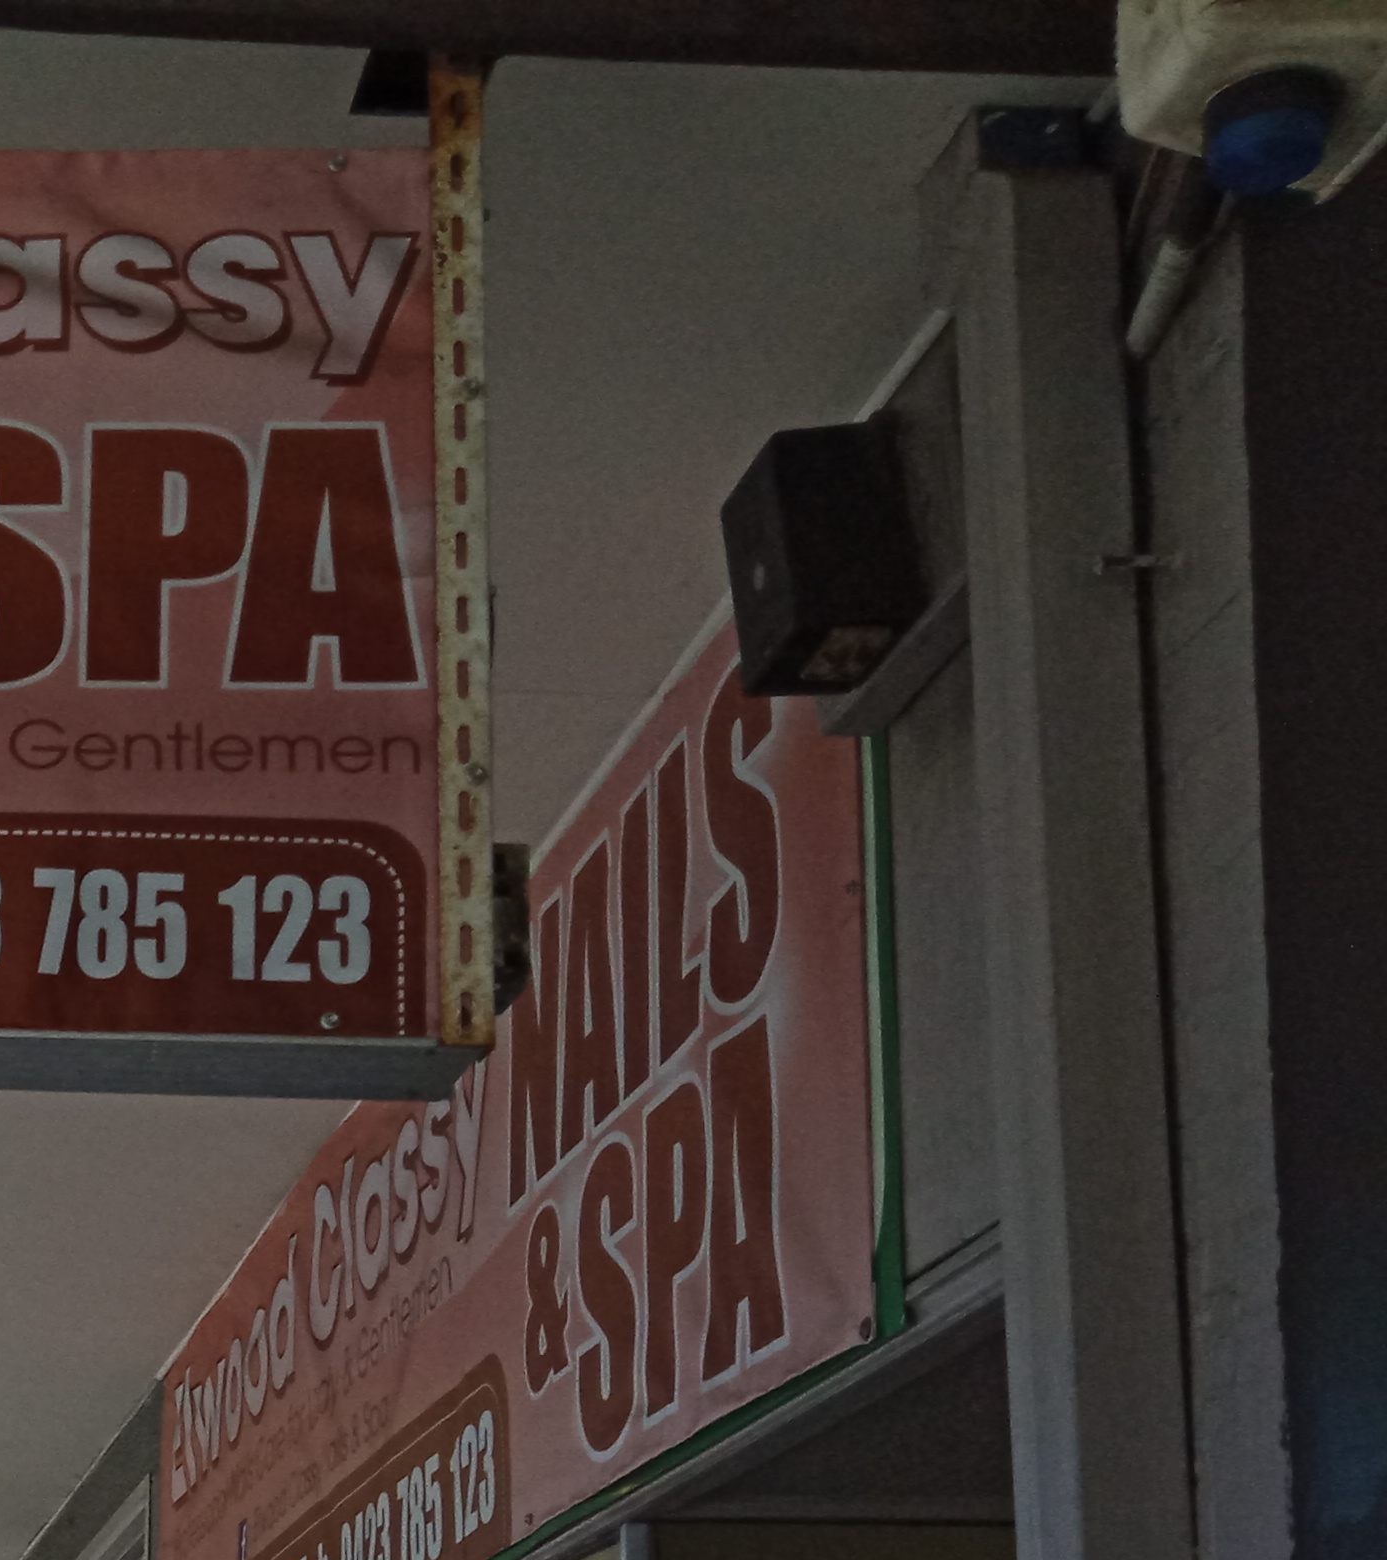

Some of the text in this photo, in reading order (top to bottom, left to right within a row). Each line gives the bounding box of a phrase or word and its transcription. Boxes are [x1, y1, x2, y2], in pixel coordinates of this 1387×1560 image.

[7, 718, 423, 777] Gentlemen
[32, 866, 201, 981] 785
[217, 870, 372, 985] 123
[508, 655, 781, 1214] NAILS
[172, 1231, 297, 1510] Elwood
[307, 1057, 489, 1352] Classy
[525, 1008, 790, 1455] & SPA
[449, 1409, 495, 1544] 123
